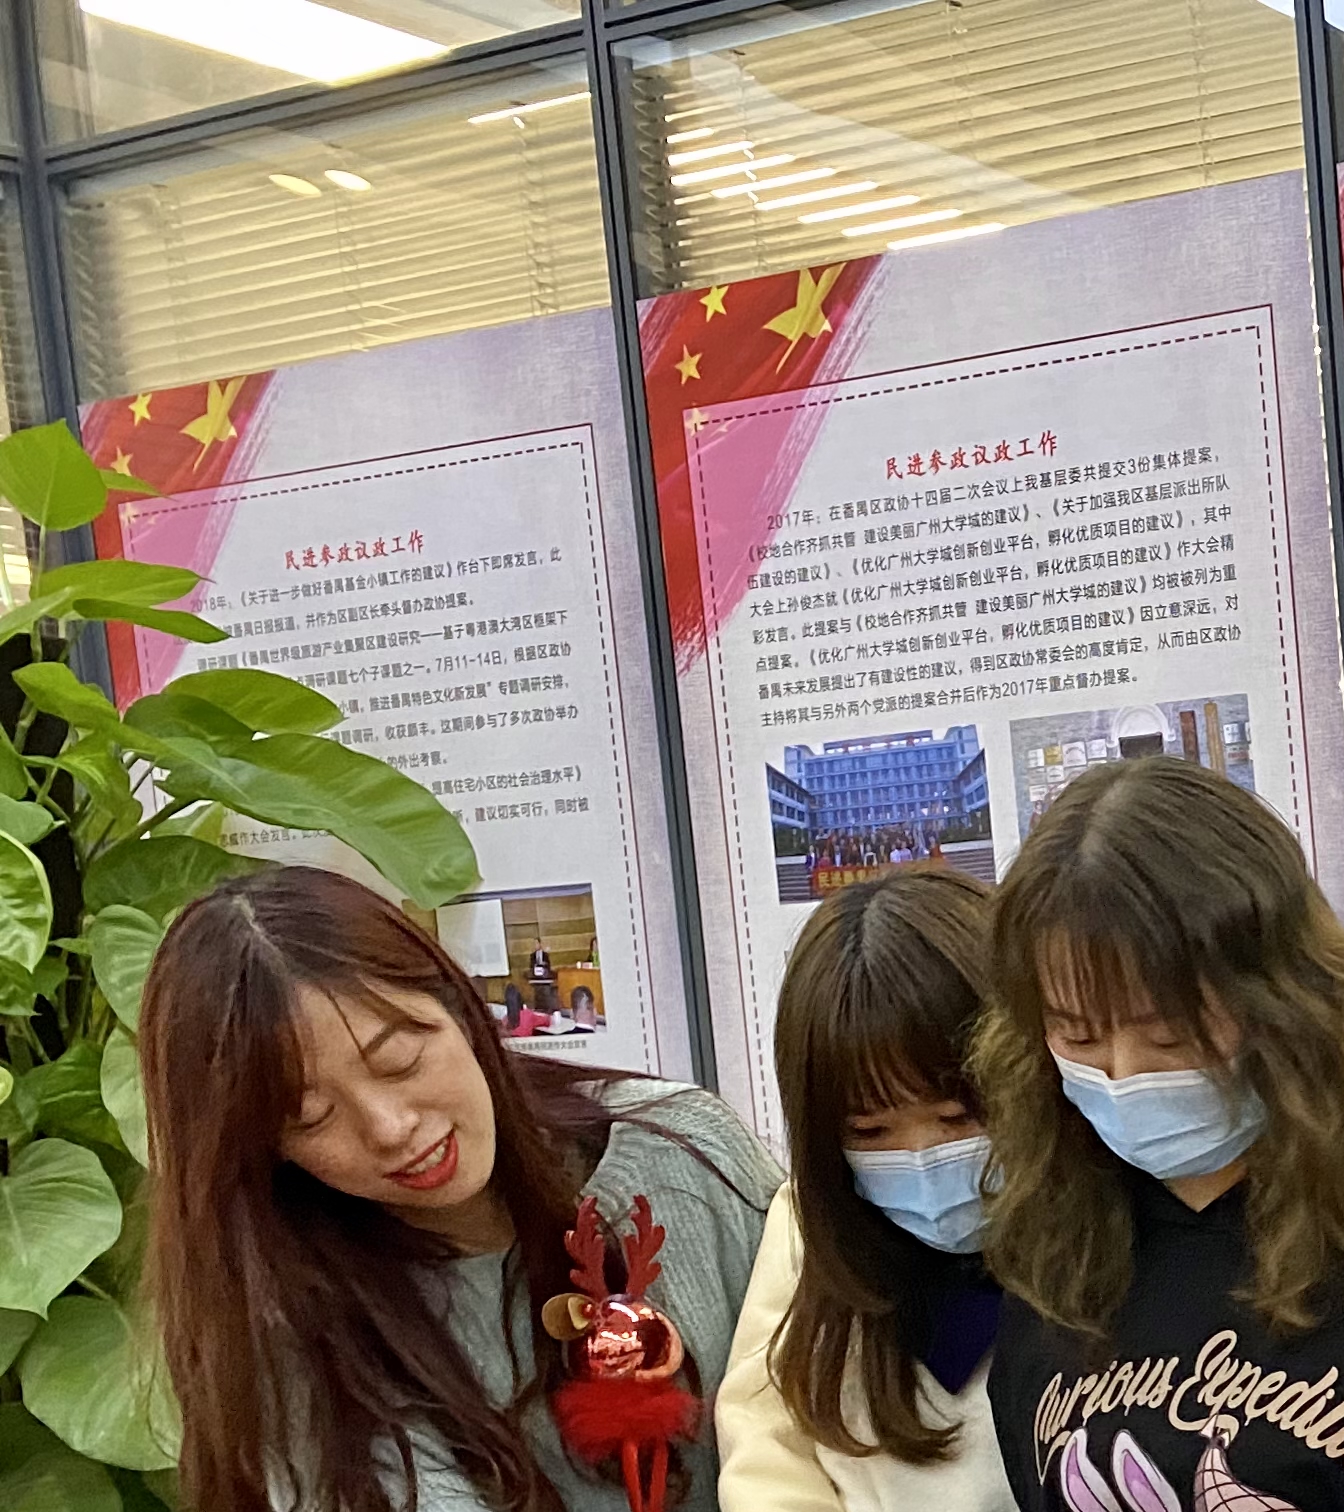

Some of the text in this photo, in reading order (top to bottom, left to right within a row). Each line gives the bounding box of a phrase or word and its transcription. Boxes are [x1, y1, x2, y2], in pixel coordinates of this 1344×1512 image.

[885, 432, 1058, 481] 民进参政议政工作
[283, 529, 425, 573] 民进参政议政工作
